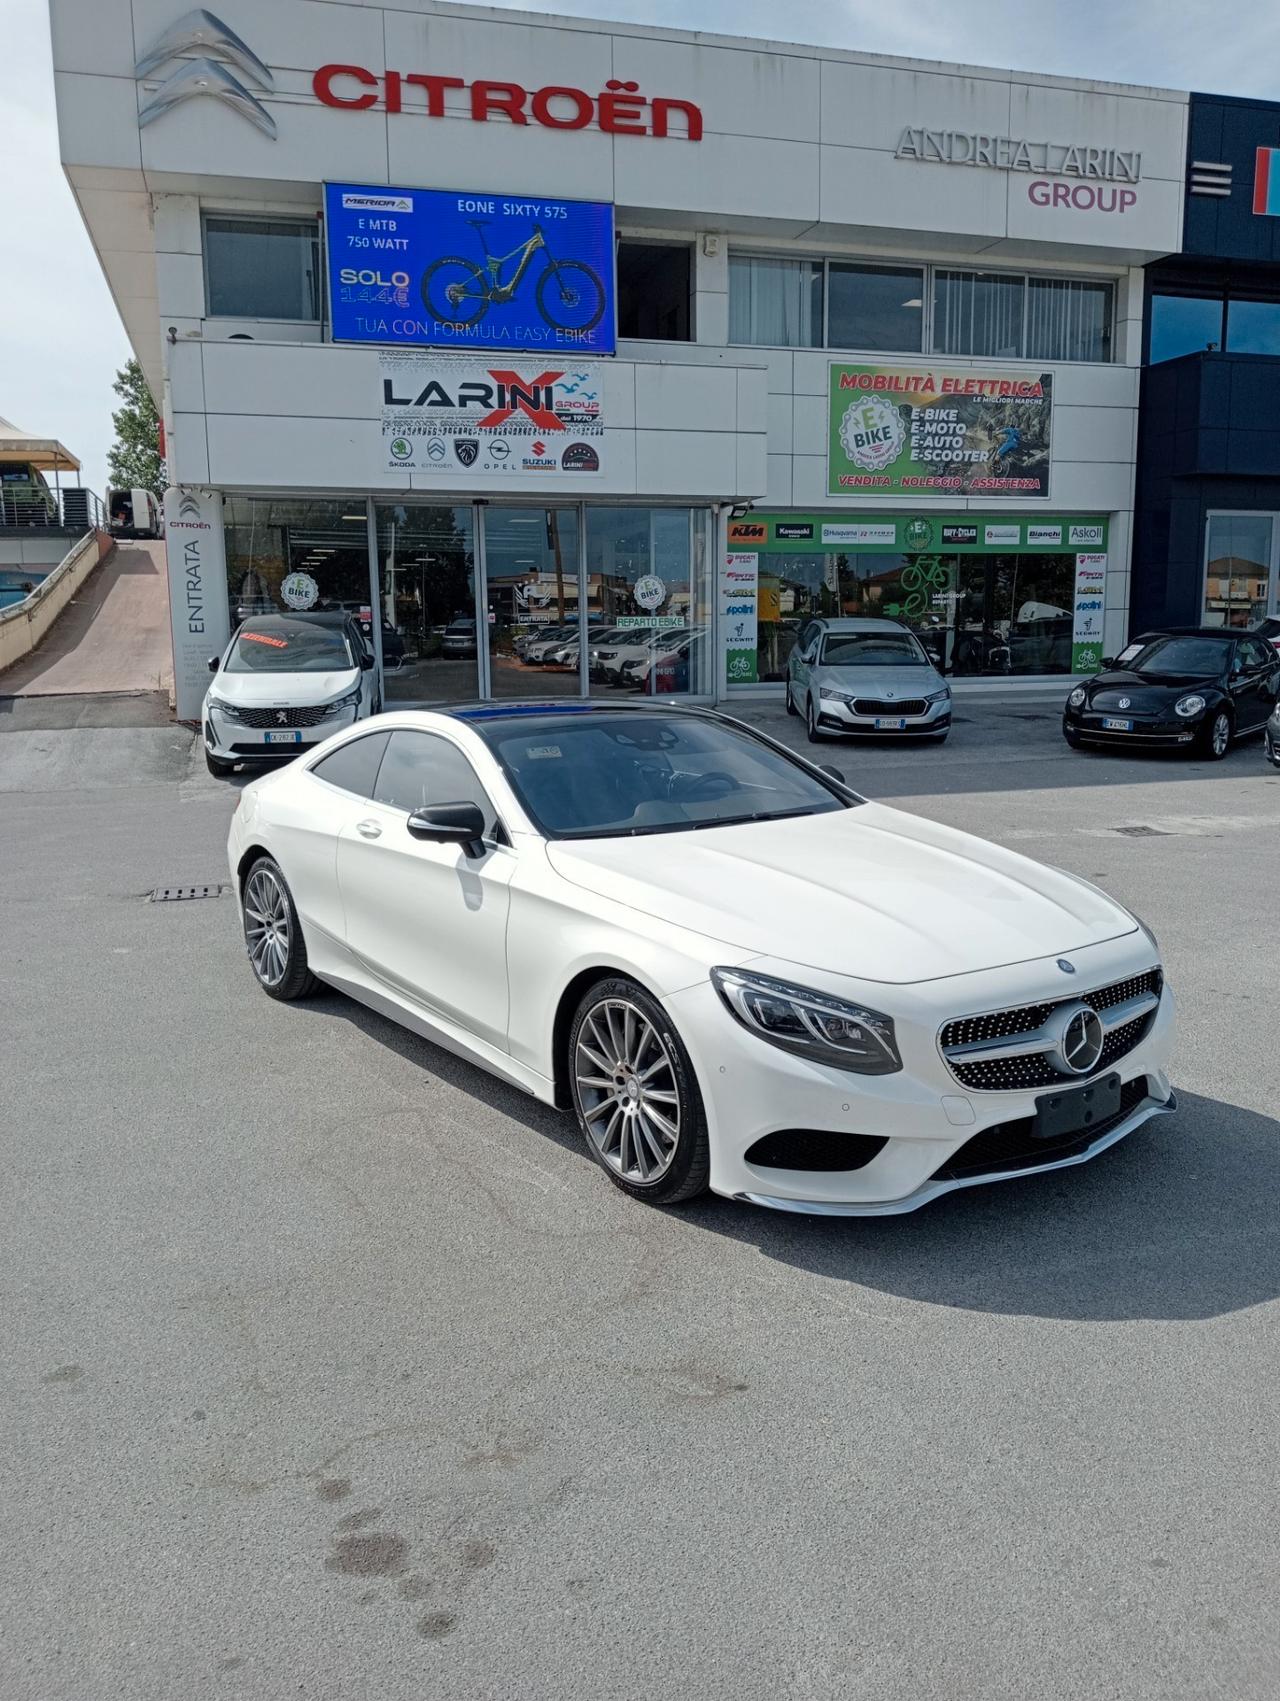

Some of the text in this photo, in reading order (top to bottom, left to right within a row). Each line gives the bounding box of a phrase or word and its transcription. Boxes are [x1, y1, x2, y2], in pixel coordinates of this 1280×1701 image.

[894, 126, 1142, 184] ANDREA LARINI
[345, 198, 395, 208] MERIDA
[1028, 181, 1137, 213] GROUP
[457, 199, 568, 219] EONE SIXTY 575
[358, 218, 397, 232] E MTB
[347, 236, 409, 250] 750 WATT
[340, 268, 410, 287] SOLO
[355, 317, 597, 344] TUA CON FORMULA EASY EBIKE
[839, 372, 1043, 397] MOBILITÀ ELETTRICA
[555, 400, 600, 409] GROUP
[862, 406, 878, 430] E
[911, 408, 958, 421] E-BIKE
[910, 421, 967, 434] E-MOTO
[853, 425, 892, 448] BIKE
[910, 435, 963, 448] E-AUTO
[522, 458, 557, 466] SUZUKI
[910, 449, 989, 463] E-SCOOTER
[839, 475, 891, 486] VENDITA
[901, 476, 962, 488] NOLEGGIO
[970, 478, 1041, 489] ASSISTENZA
[731, 524, 765, 537] KTM
[779, 527, 810, 535] Kawasaki
[1071, 527, 1101, 538] Askoll
[184, 540, 205, 633] ENTRATA
[296, 577, 304, 589] E
[288, 587, 310, 598] BIKE
[640, 588, 659, 599] BIKE
[618, 617, 657, 627] REPARTO
